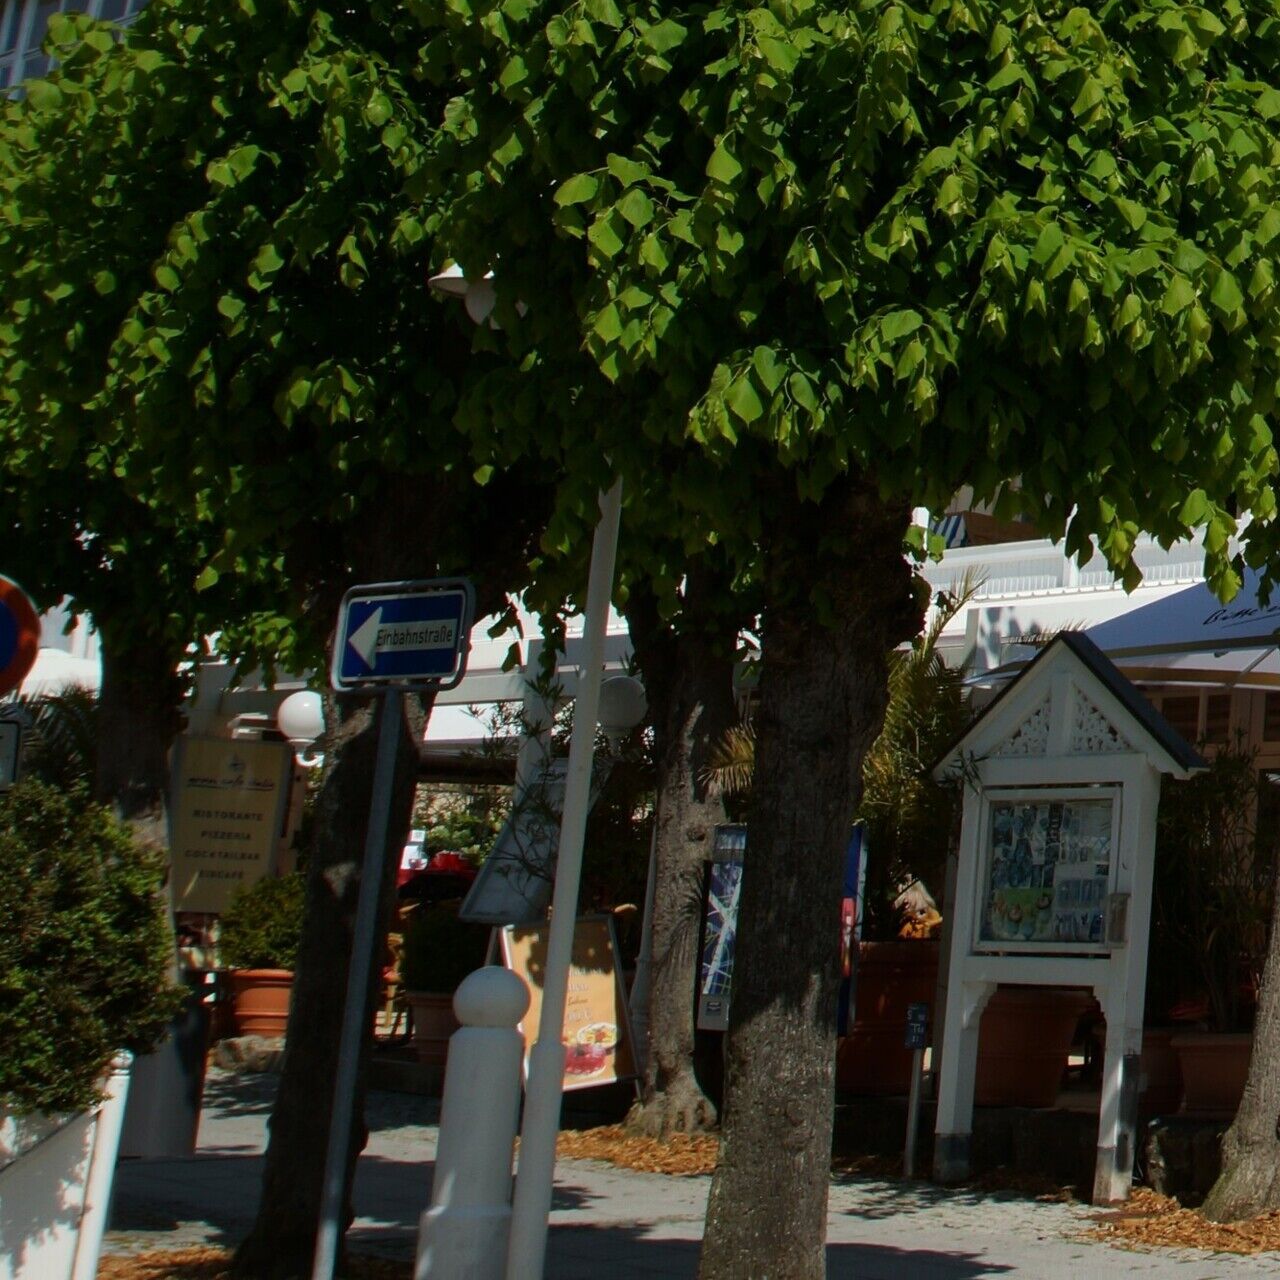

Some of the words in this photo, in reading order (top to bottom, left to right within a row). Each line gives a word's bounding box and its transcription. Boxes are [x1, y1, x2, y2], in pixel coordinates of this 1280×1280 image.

[376, 625, 453, 647] Einbahnstraße
[192, 809, 264, 821] RISTORANTE
[201, 830, 251, 840] PIZZERIA
[184, 849, 260, 860] COCKTAILBAR
